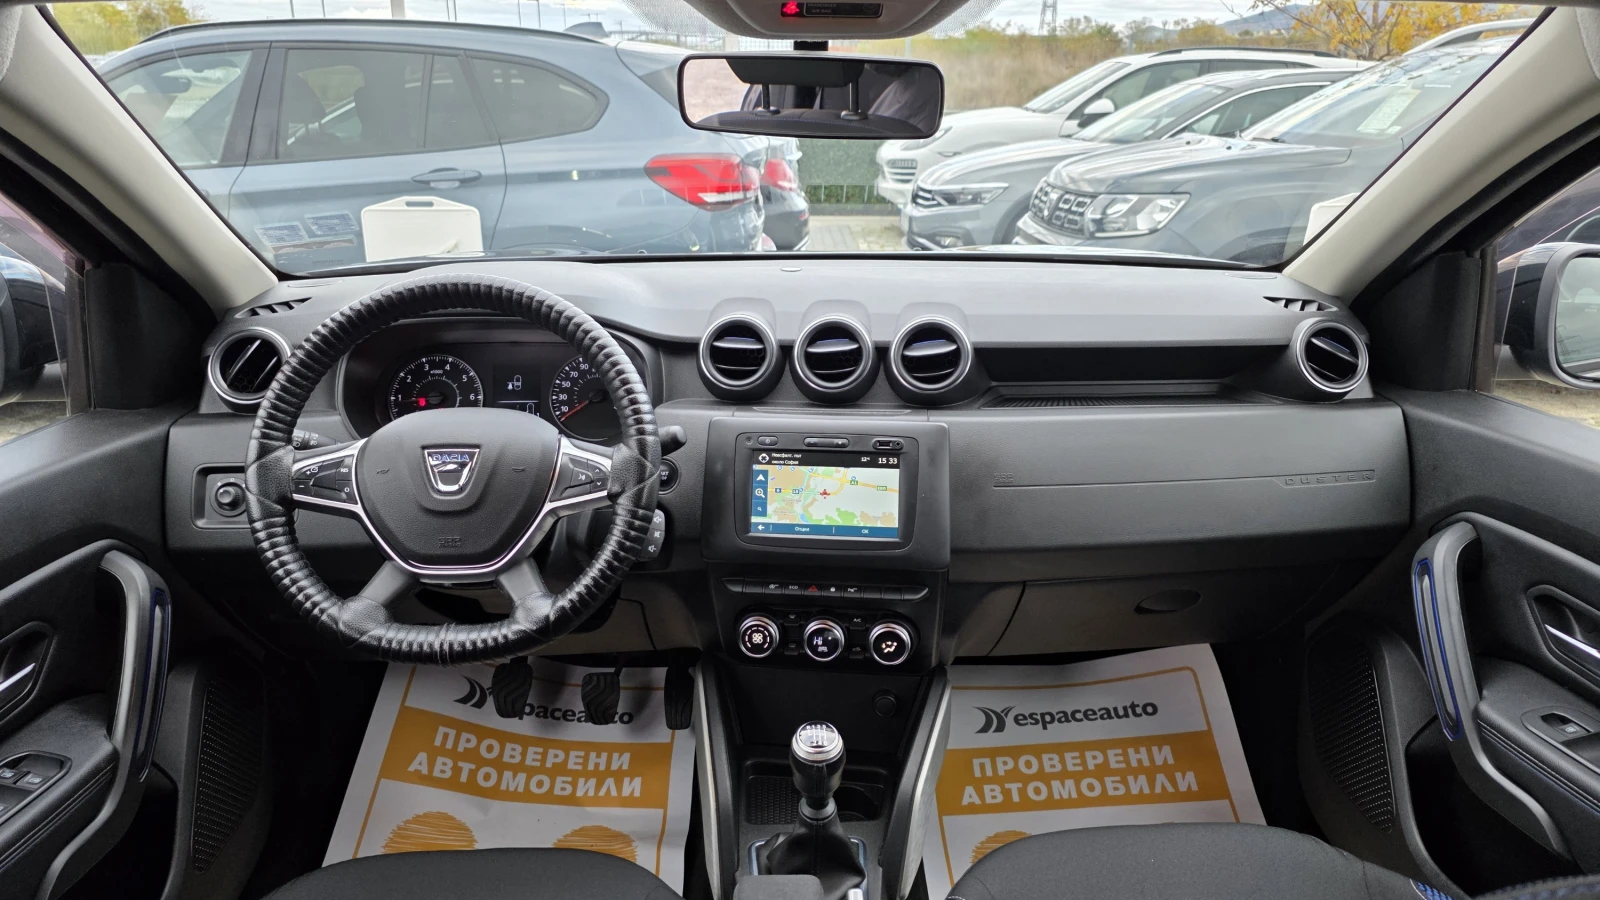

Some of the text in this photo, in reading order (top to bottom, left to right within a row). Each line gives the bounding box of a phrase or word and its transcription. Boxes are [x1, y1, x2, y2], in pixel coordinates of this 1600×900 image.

[431, 453, 470, 462] DACIA
[1285, 472, 1372, 486] DUSTER
[1014, 701, 1159, 730] espaceauto
[434, 725, 632, 772] ПРОВЕРЕНИ
[972, 745, 1175, 778] ПРОВЕРЕНИ
[408, 752, 642, 798] АВТОМОБИЛИ
[961, 771, 1199, 806] АВТОМОБИЛИ
